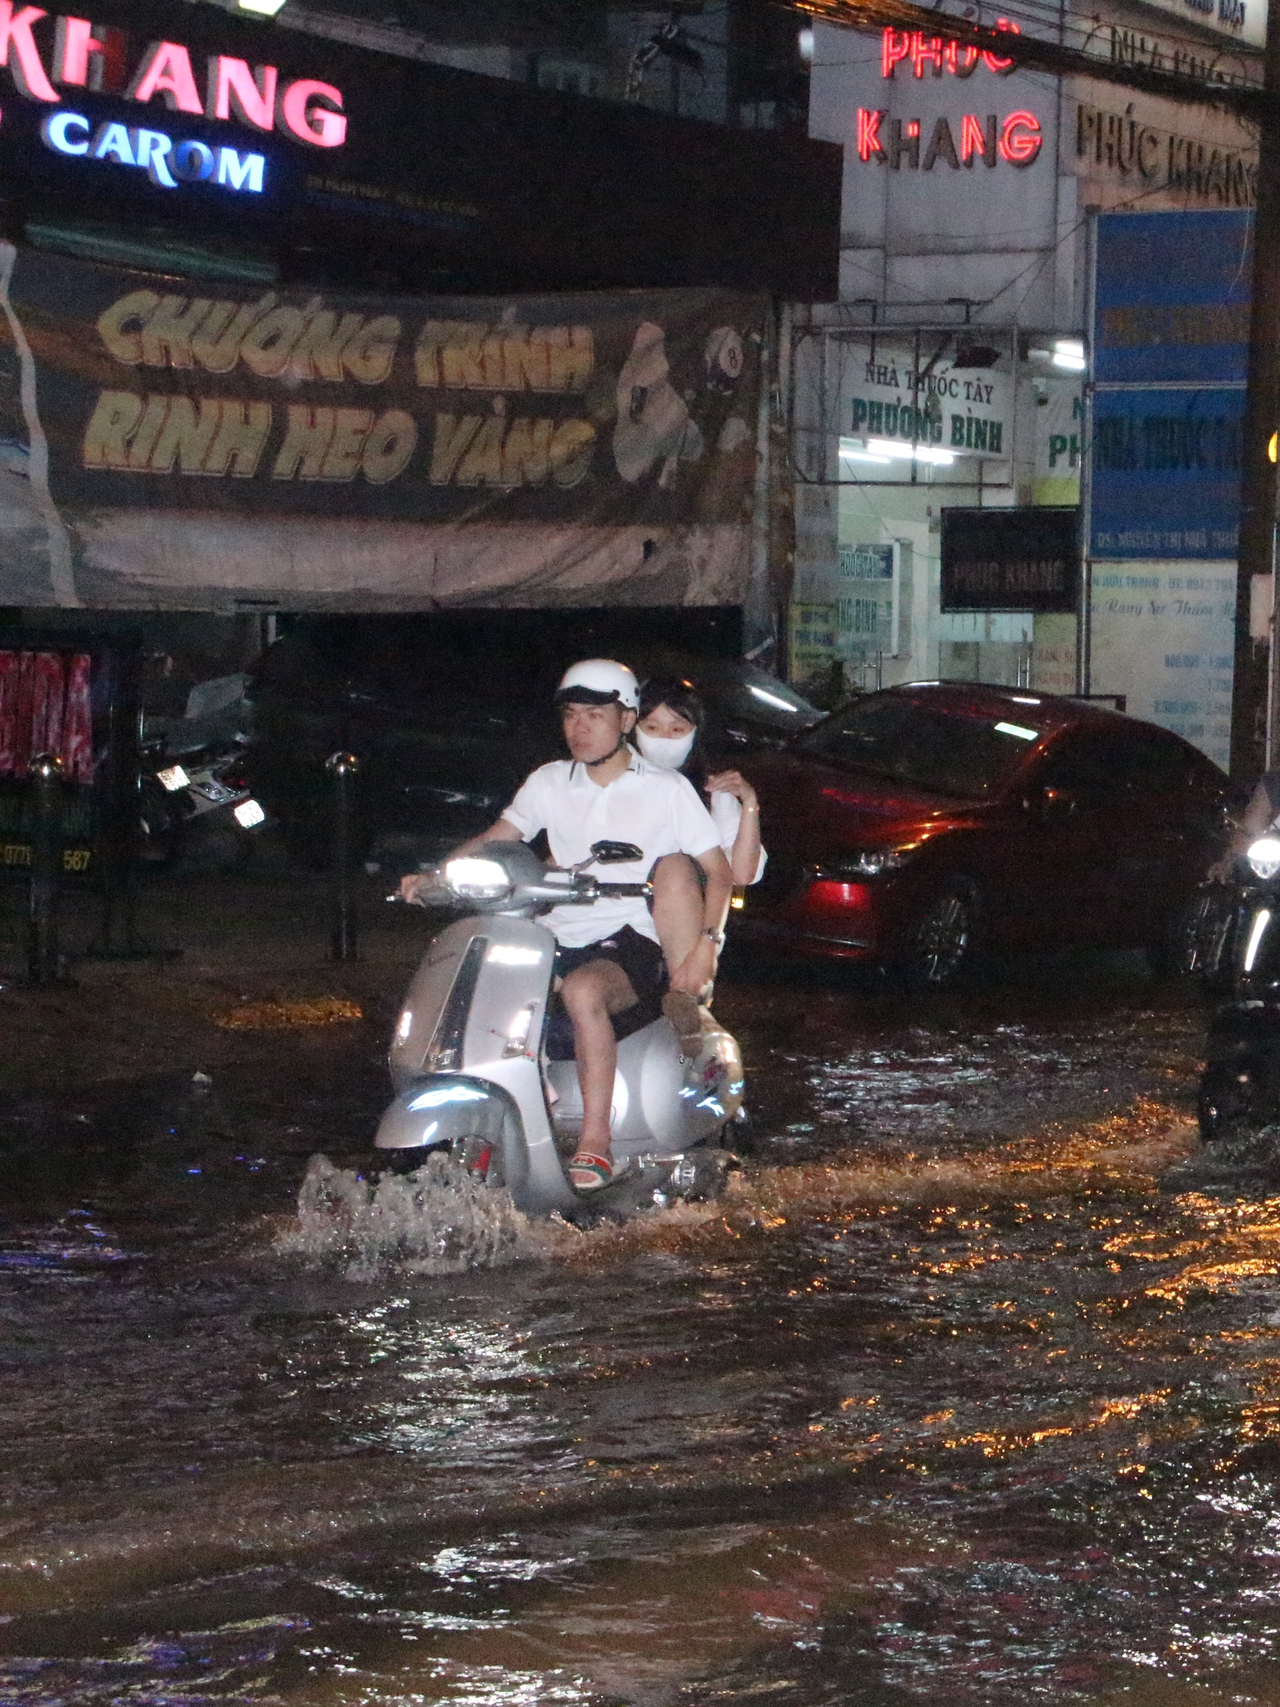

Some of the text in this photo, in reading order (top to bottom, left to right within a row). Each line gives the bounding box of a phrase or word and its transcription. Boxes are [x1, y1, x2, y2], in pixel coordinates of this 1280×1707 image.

[0, 0, 349, 149] KHANG
[44, 111, 266, 193] CAROM
[856, 107, 1042, 171] KHANG
[96, 288, 402, 386] CHƯƠNG
[865, 359, 899, 388] NHÀ
[962, 376, 995, 405] TÂY
[82, 390, 274, 479] RINH
[273, 404, 419, 485] HEO
[950, 406, 1004, 454] BÌNH
